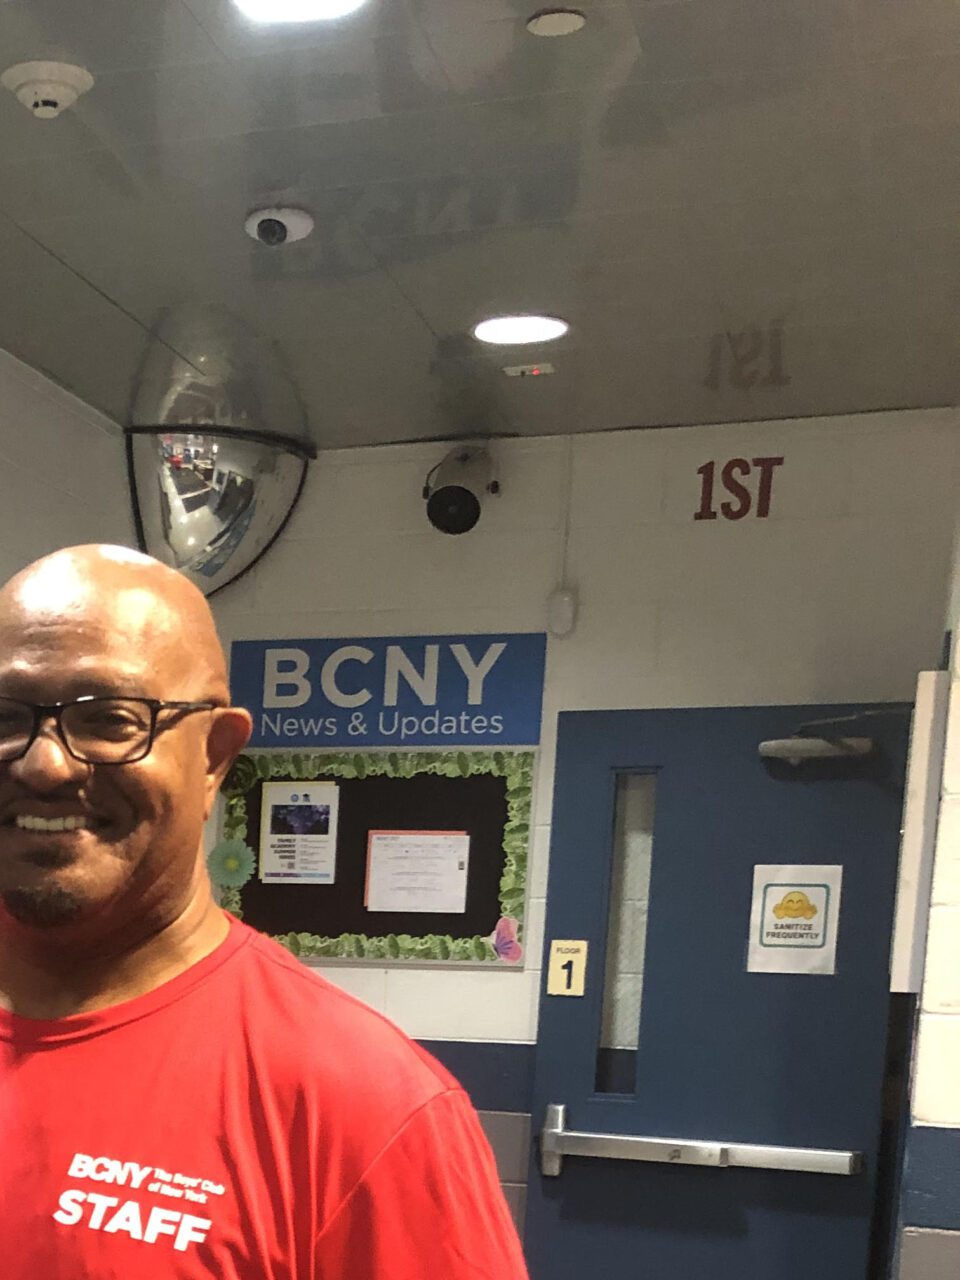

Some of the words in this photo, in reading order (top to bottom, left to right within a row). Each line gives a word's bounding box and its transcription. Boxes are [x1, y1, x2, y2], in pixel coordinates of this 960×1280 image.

[693, 456, 784, 521] 1ST
[262, 642, 508, 709] BCNY
[261, 713, 337, 737] News
[347, 712, 368, 736] &
[379, 710, 504, 740] Updates
[561, 960, 573, 990] 1
[68, 1153, 151, 1189] BCNY
[52, 1189, 212, 1252] STAFF
